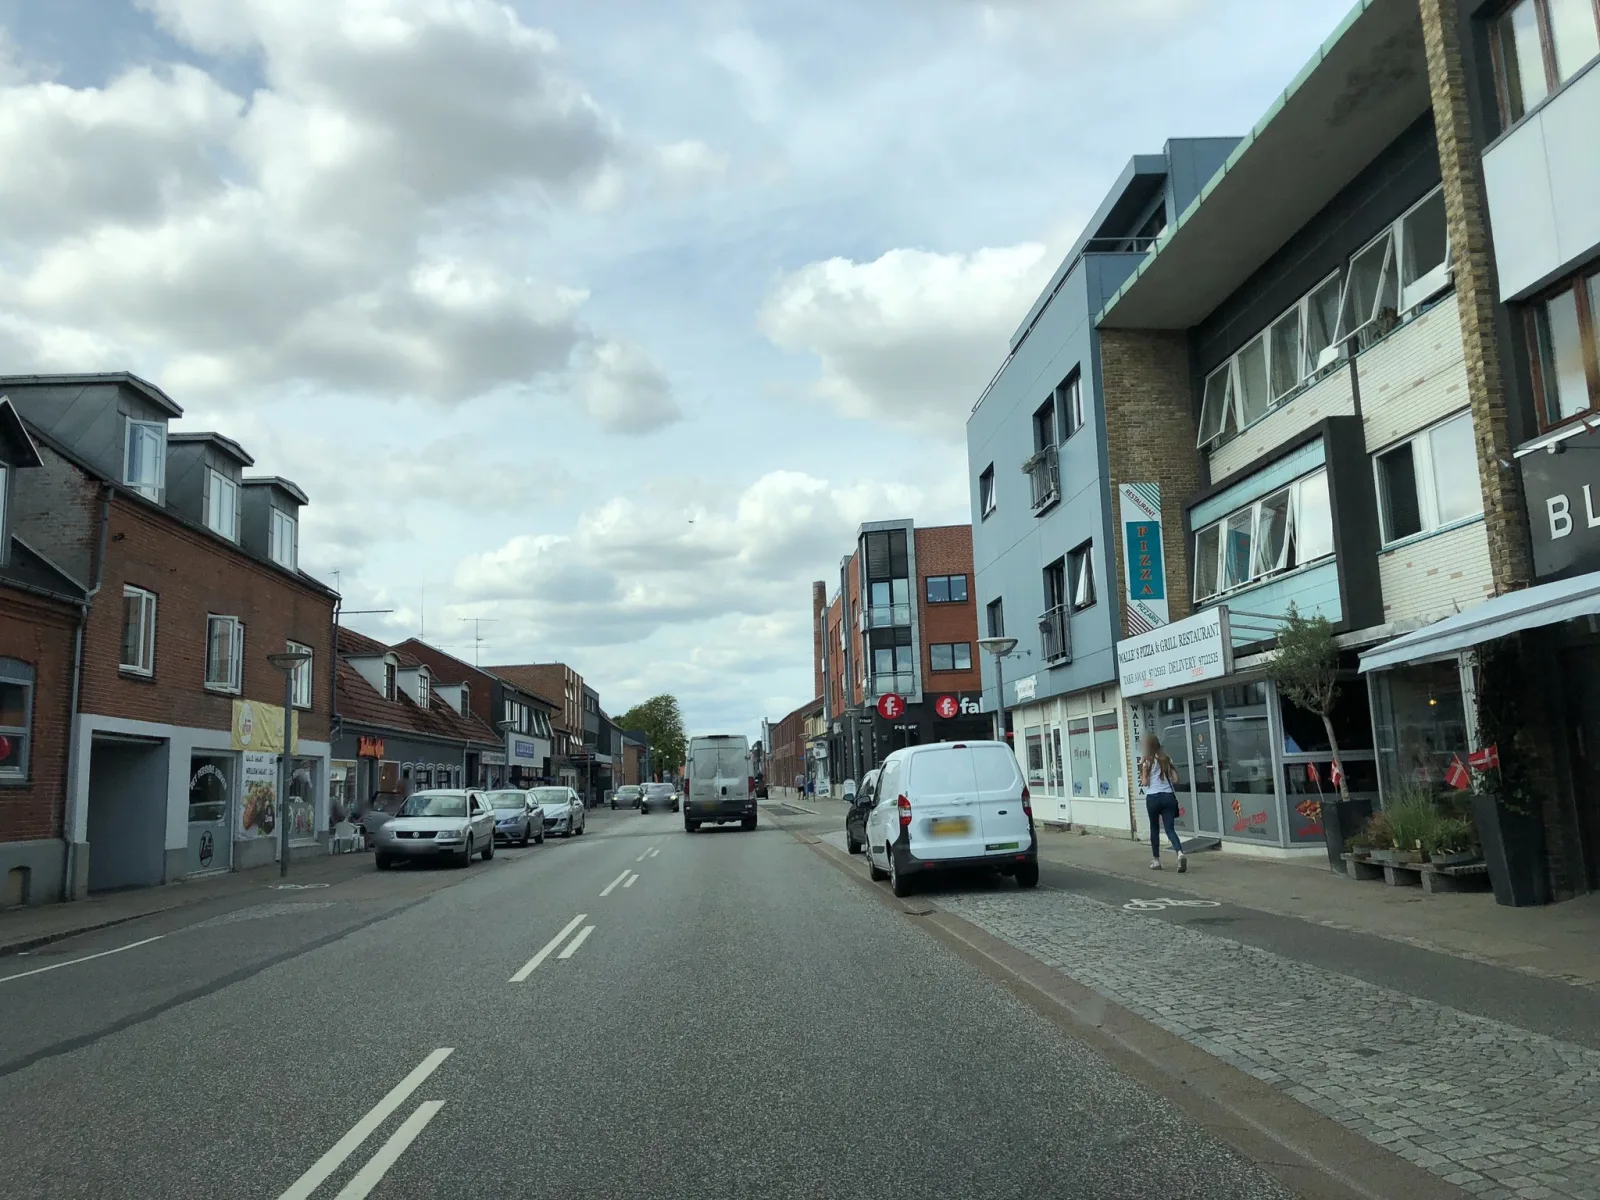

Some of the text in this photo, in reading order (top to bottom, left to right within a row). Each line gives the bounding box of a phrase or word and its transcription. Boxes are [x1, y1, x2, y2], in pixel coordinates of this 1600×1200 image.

[1124, 488, 1156, 517] RESTAURANT
[1136, 526, 1154, 594] PIZZA
[1136, 602, 1159, 625] PIZZARIA
[1140, 644, 1155, 659] PIZZA
[1156, 643, 1160, 653] &
[1160, 636, 1178, 652] GRILL
[1179, 622, 1219, 646] RESTAURANT
[1168, 656, 1197, 674] DELIVERY
